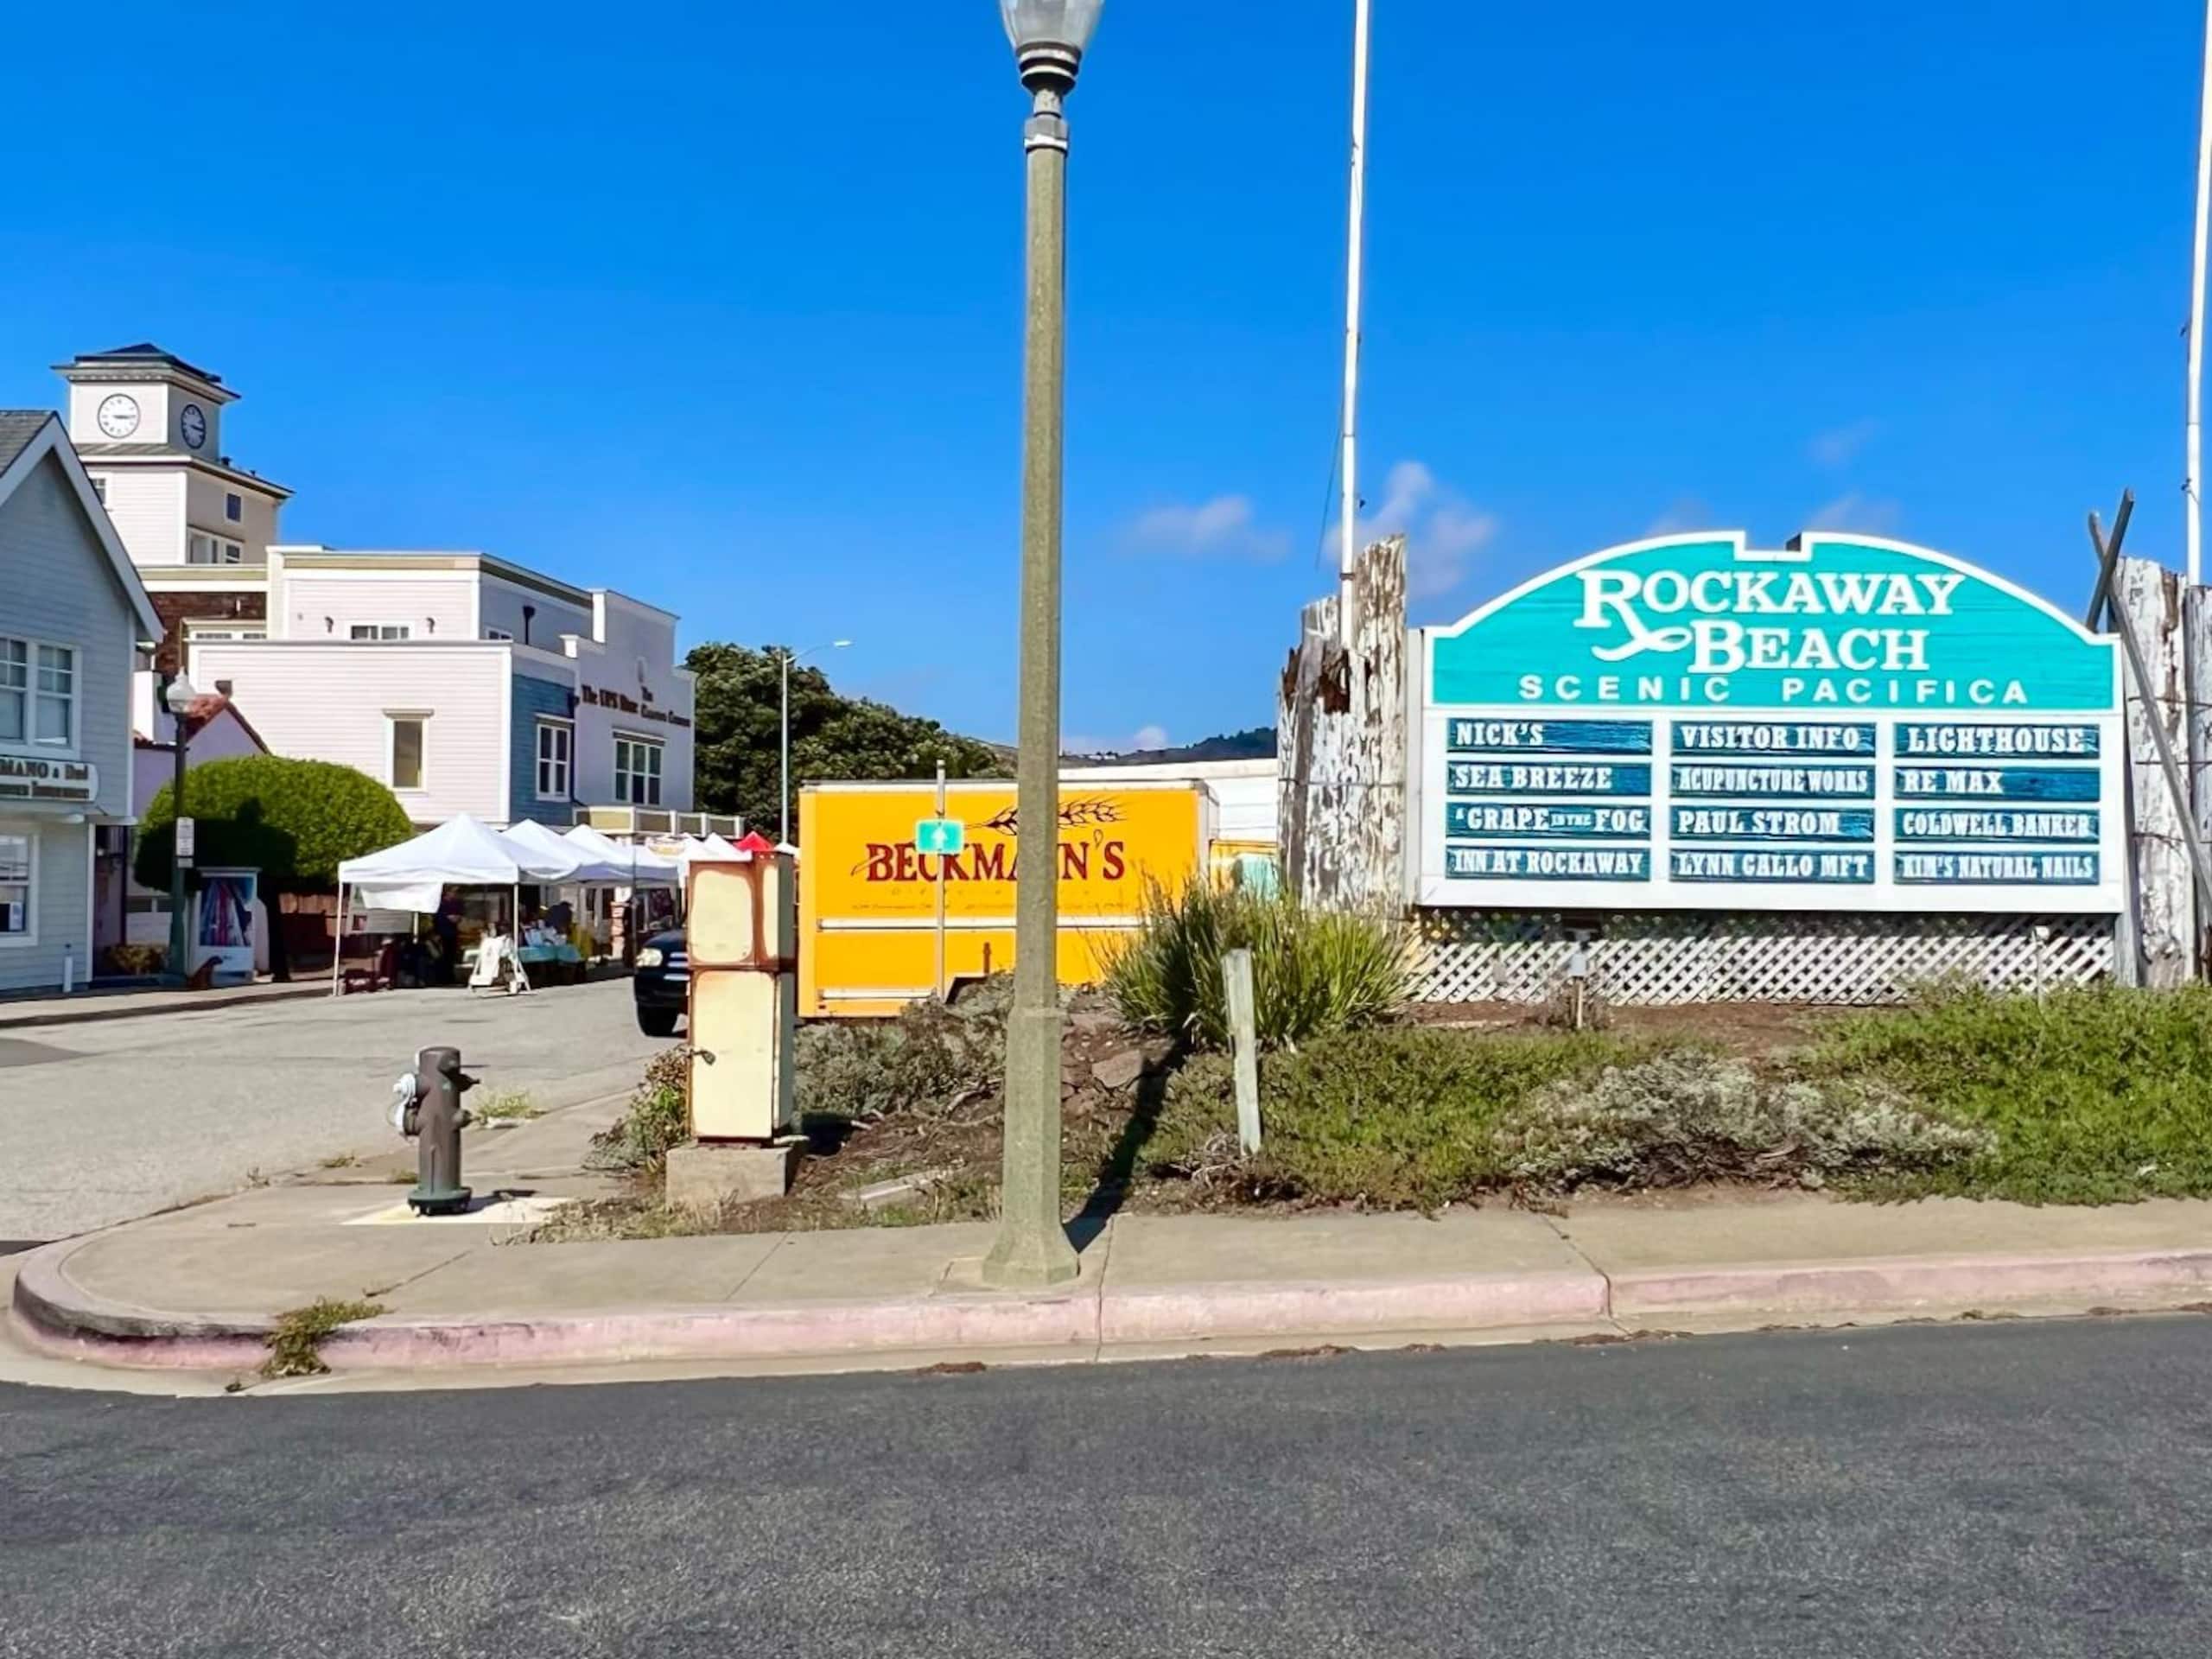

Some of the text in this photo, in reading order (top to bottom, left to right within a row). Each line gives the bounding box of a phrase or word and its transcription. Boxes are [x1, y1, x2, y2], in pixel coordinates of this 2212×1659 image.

[1573, 569, 1966, 662] ROCKAWAY
[1687, 619, 1930, 674] BEACH
[1518, 674, 2028, 705] SCENIC PACIFICA
[1456, 722, 1543, 746] NICK'S
[1681, 726, 1859, 750] VISITOR INFO
[1908, 727, 2085, 753] LIGHTHOUSE
[1454, 765, 1612, 789] SEA BREEZE
[1904, 770, 2004, 793] RE MAX
[1467, 806, 1549, 831] GRAPE
[1593, 809, 1647, 832] FOG
[1678, 810, 1840, 836] PAUL STROM
[1903, 811, 2089, 837] COLDWELL BANKER
[866, 830, 1125, 881] BECKMN'S
[1454, 849, 1643, 874] INN AT ROCKAWAY
[1678, 852, 1735, 875] LYNN
[1820, 855, 1868, 877] MFT
[1958, 856, 2037, 879] NATURAL
[2041, 857, 2093, 879] NAILS
